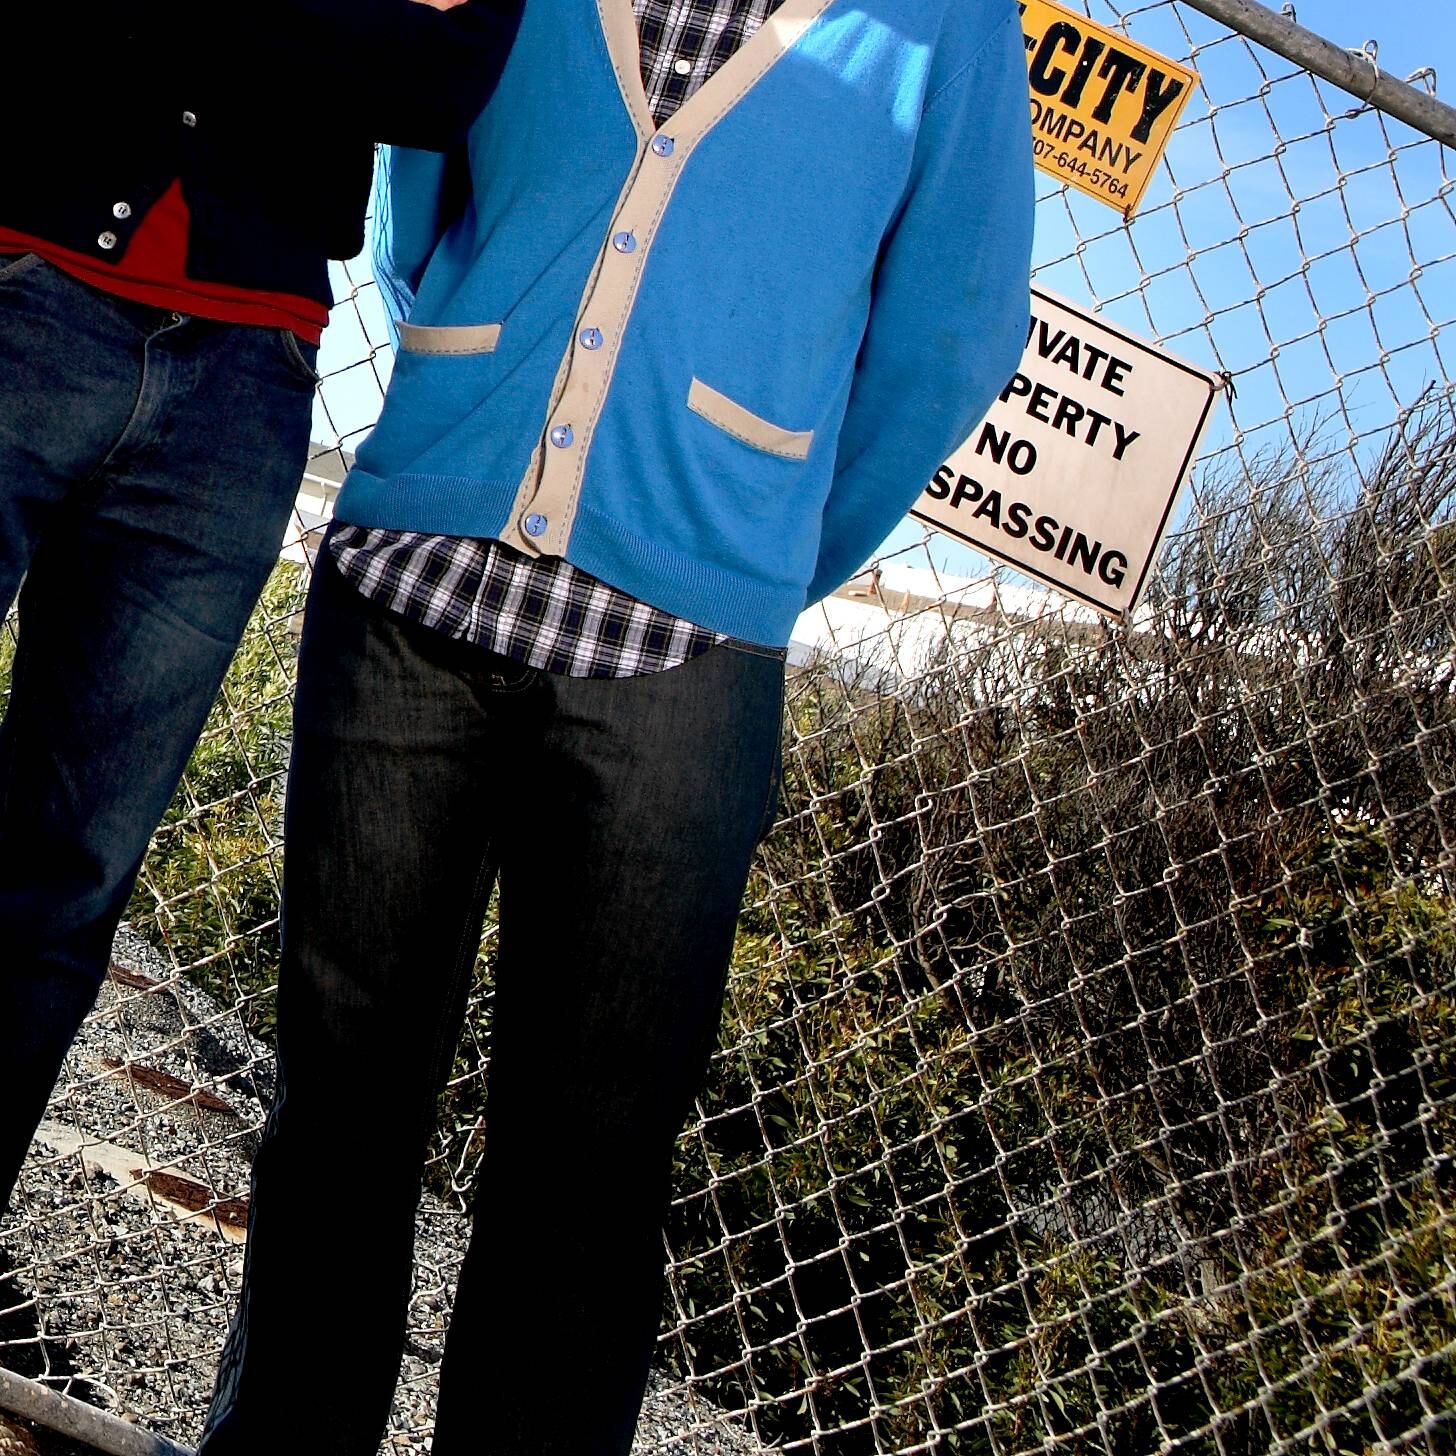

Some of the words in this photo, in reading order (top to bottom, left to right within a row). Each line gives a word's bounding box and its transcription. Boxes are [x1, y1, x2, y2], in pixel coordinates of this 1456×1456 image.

[1017, 1, 1184, 145] -CITY
[1033, 137, 1129, 199] 07-644-5764
[974, 421, 1037, 475] NO
[999, 372, 1141, 461] PERTY
[925, 464, 1128, 589] SPASSING
